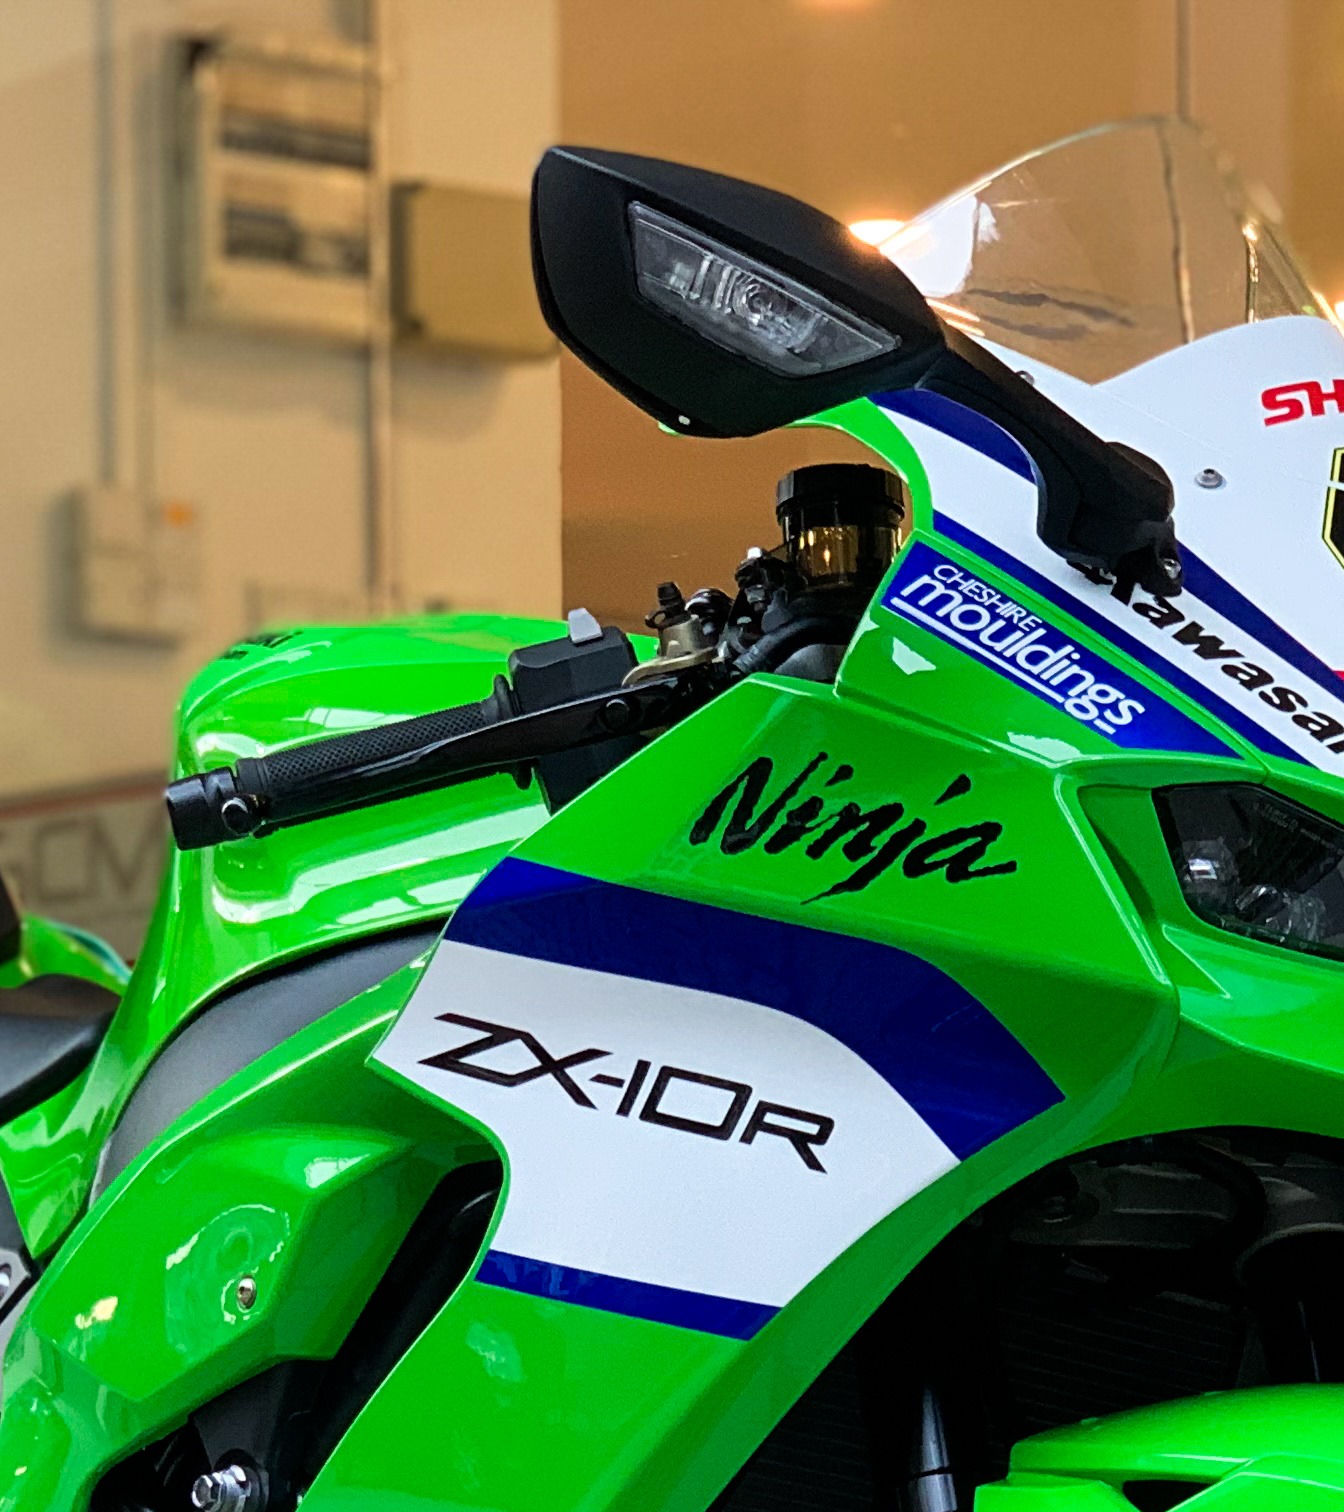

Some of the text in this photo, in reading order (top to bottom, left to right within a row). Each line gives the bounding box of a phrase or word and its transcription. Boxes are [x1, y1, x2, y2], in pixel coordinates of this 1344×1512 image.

[899, 574, 1147, 728] mouldings
[932, 563, 1044, 632] CHESHIRE
[688, 752, 1017, 905] Ninja
[417, 1012, 836, 1174] ZX-10R
